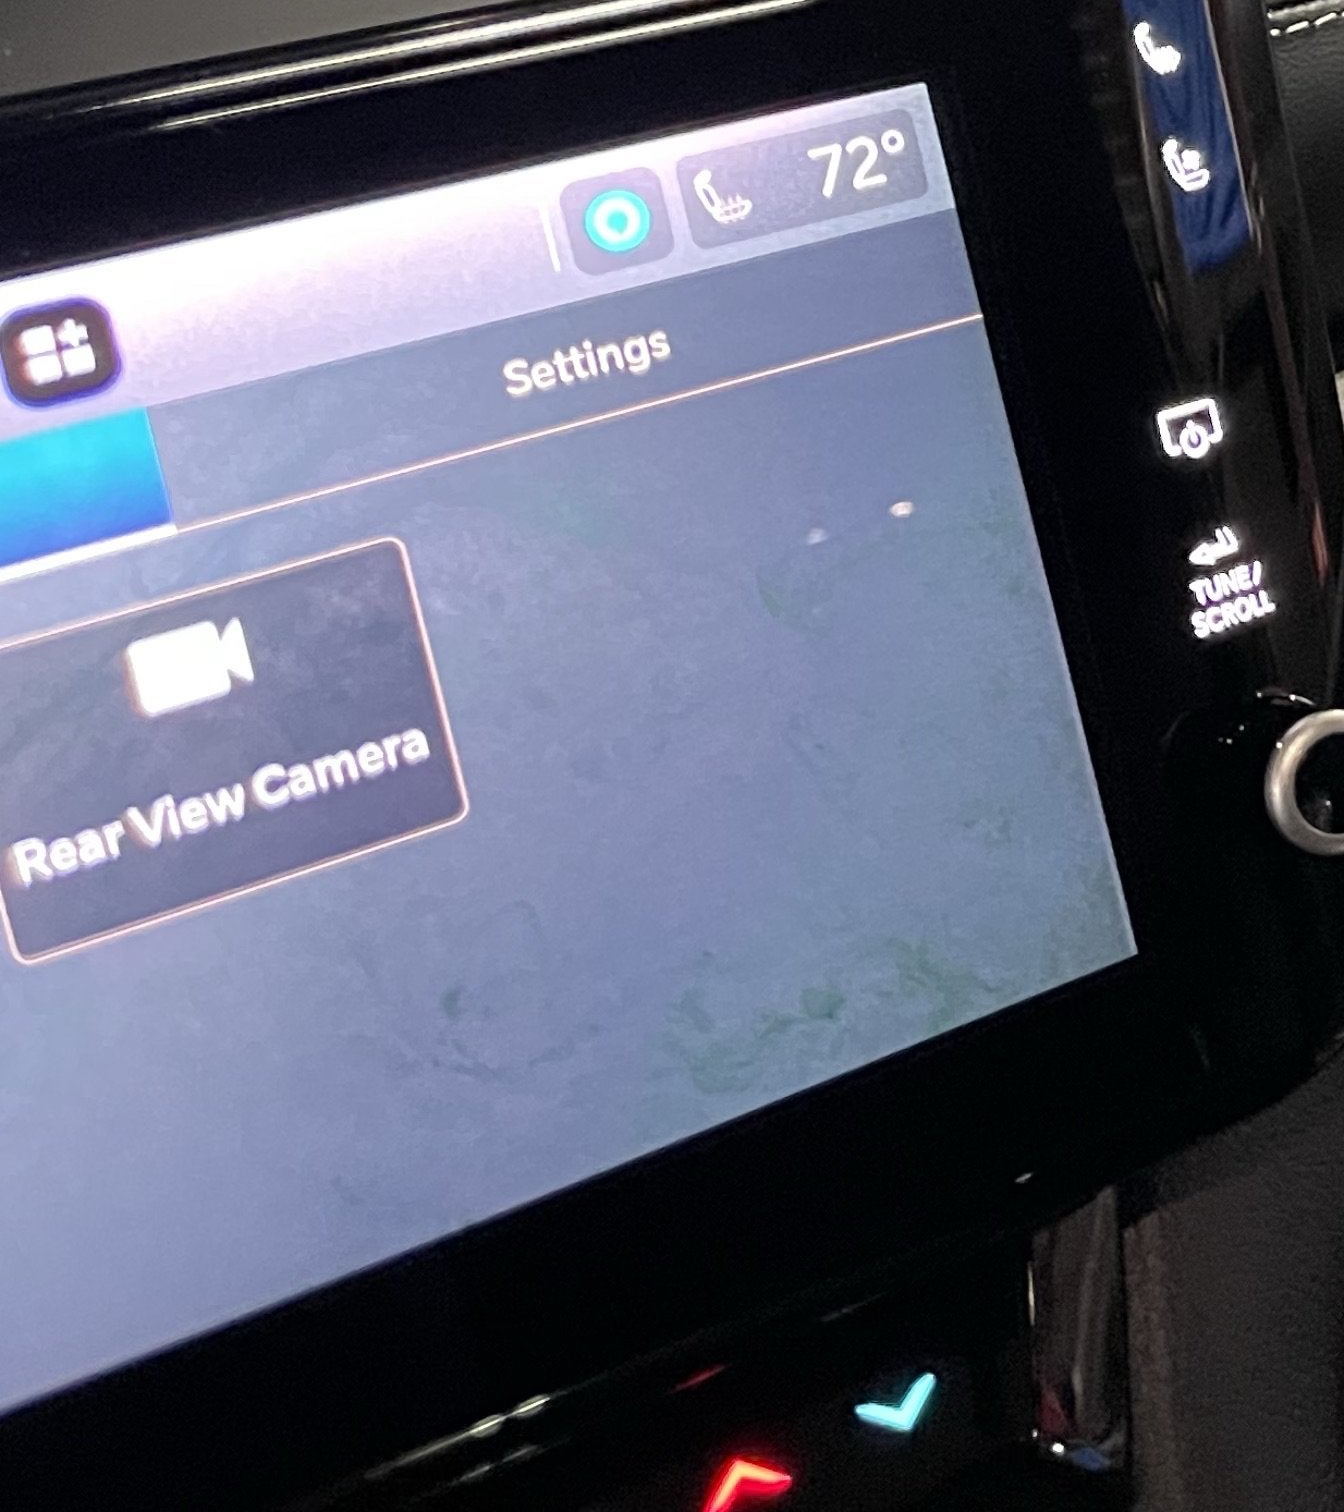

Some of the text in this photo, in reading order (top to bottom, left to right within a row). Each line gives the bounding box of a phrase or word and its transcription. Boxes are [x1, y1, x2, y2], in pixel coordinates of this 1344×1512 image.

[502, 330, 672, 396] Settings
[1188, 560, 1262, 606] TUNE/
[1191, 590, 1276, 638] SCROLL
[10, 727, 431, 888] Rear View Camera
